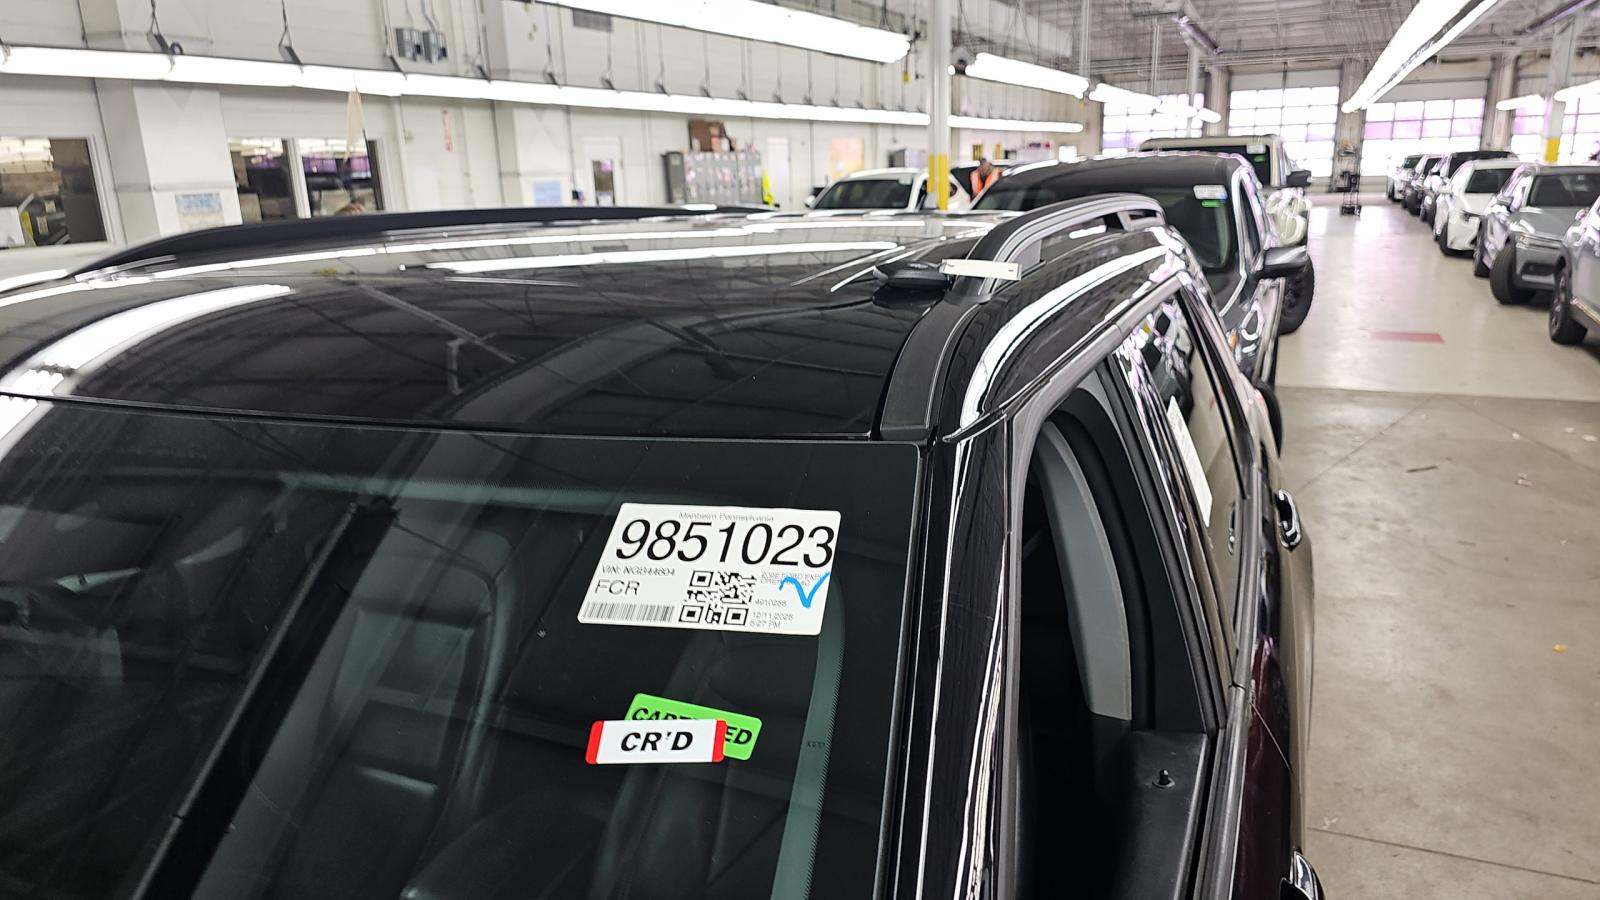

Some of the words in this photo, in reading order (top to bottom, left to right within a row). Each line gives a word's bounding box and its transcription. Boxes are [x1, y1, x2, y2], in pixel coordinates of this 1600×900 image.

[679, 511, 717, 520] Manheim
[719, 512, 774, 522] Pennsylvania
[616, 518, 835, 568] 9851023
[594, 579, 640, 595] FCR
[769, 621, 781, 630] PM
[620, 731, 693, 752] CR'D
